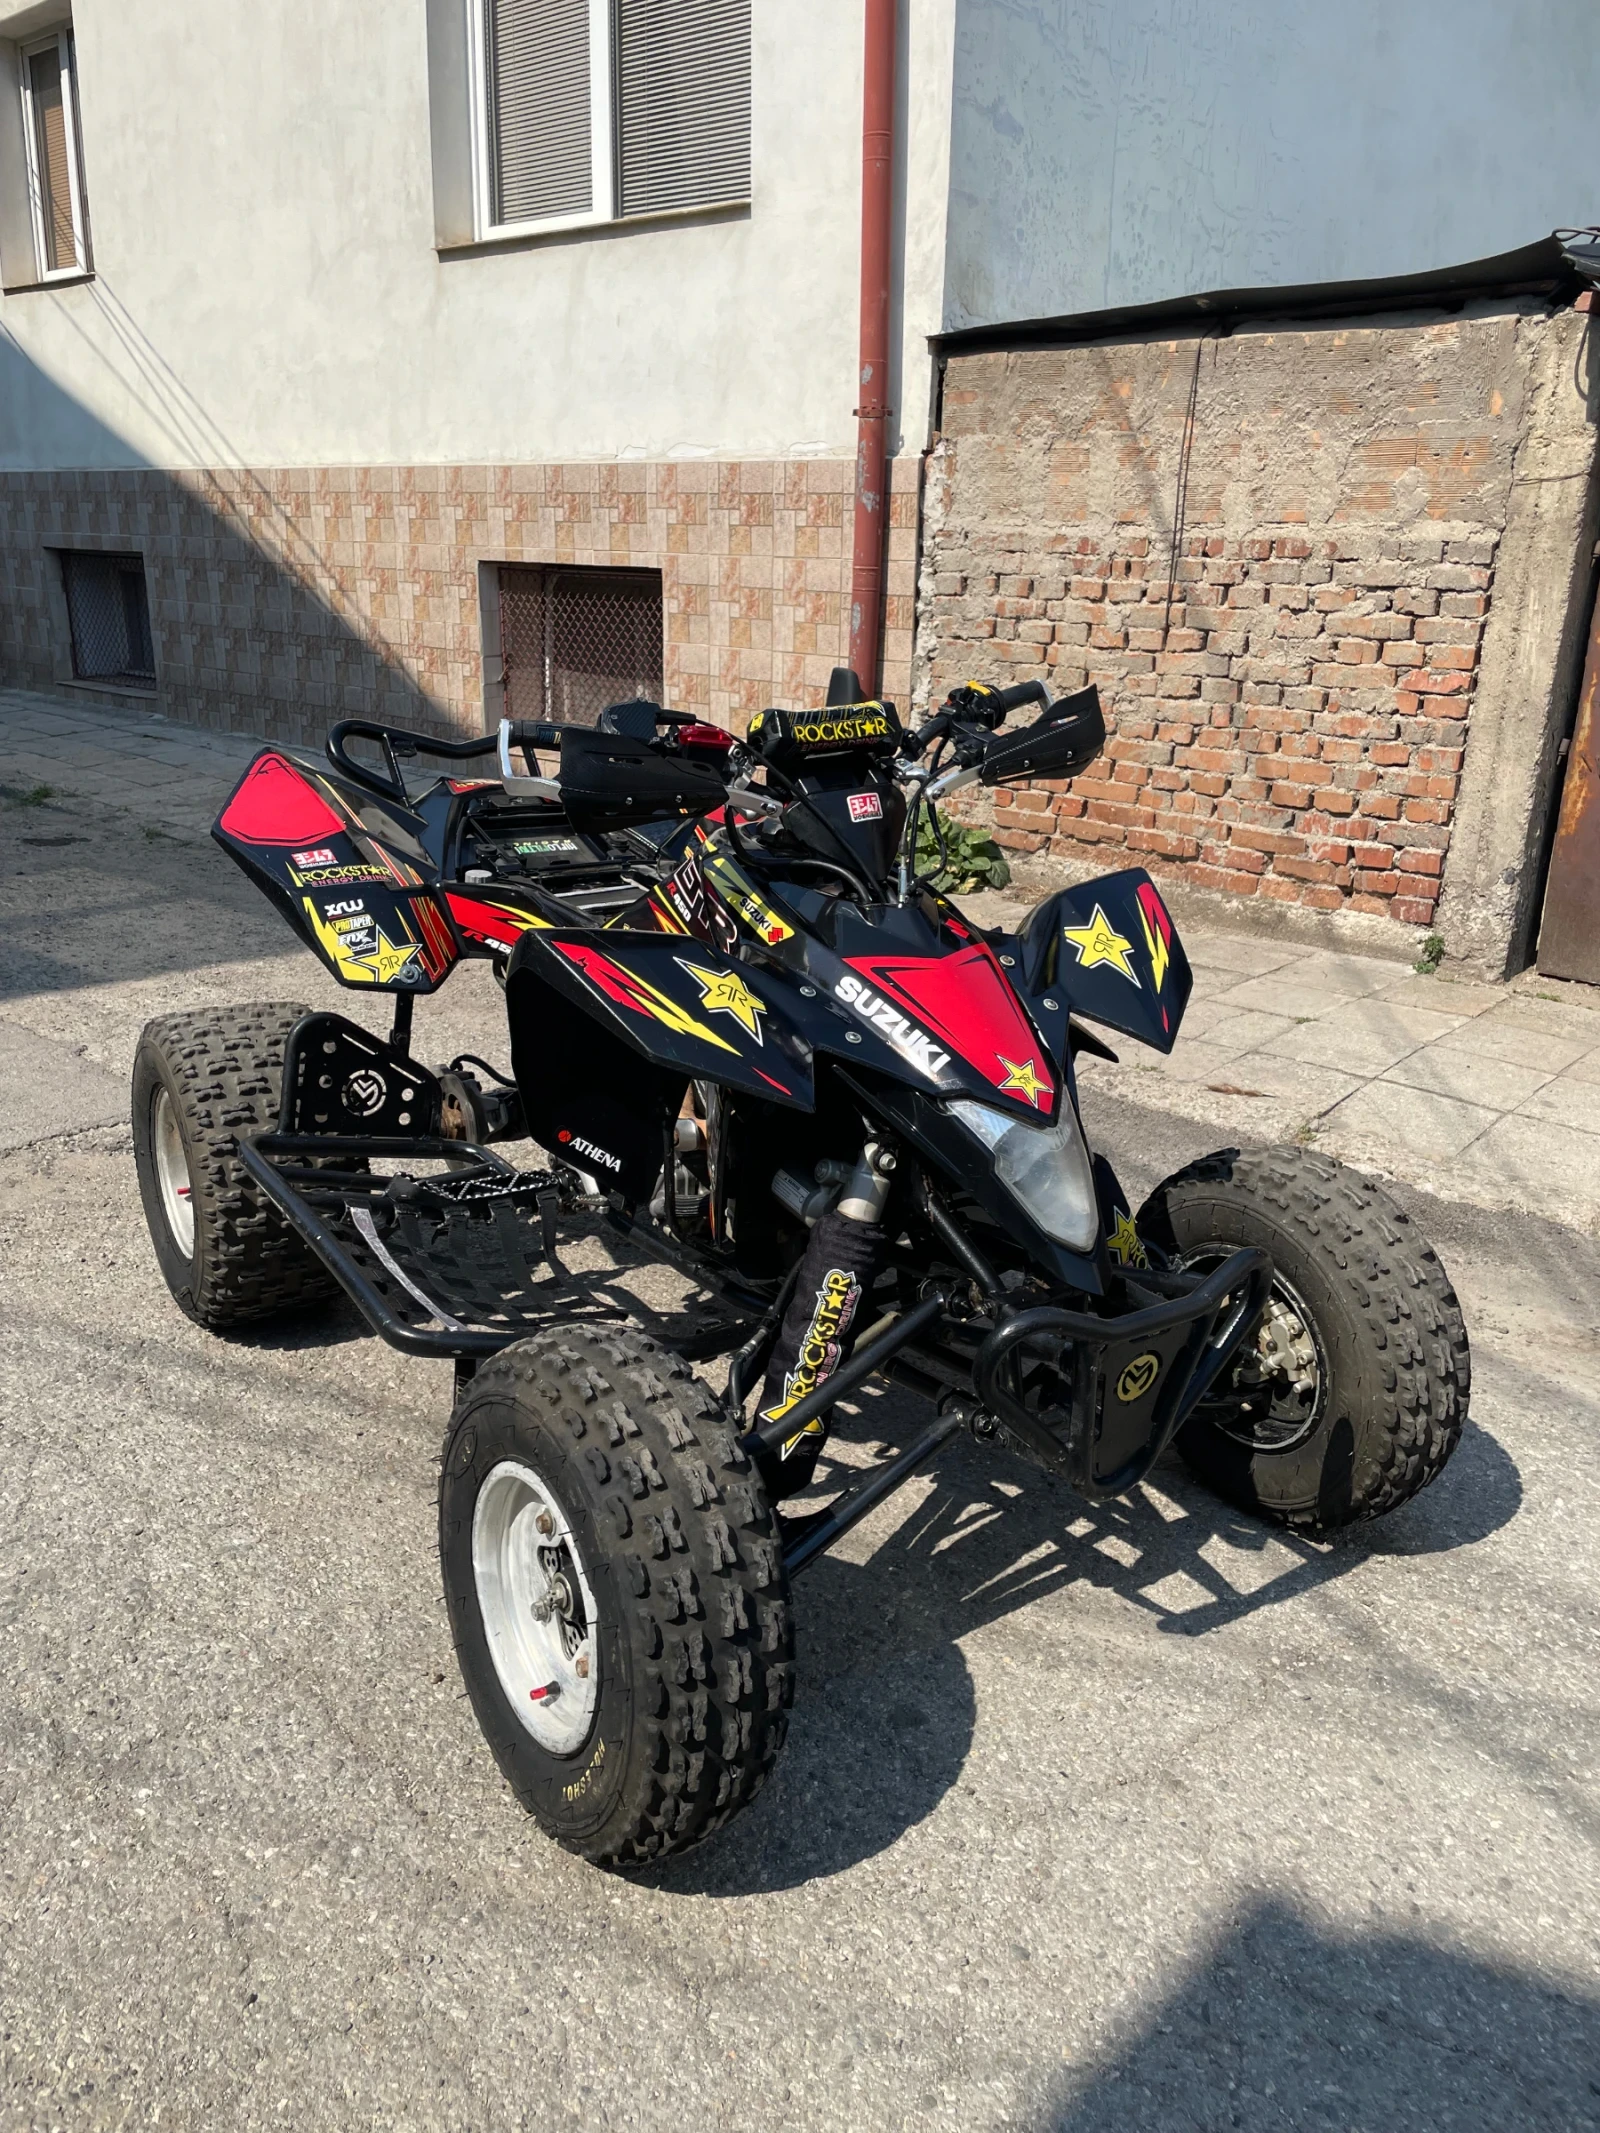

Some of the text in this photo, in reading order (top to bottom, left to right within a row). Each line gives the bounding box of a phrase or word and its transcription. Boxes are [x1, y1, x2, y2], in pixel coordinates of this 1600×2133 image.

[311, 876, 354, 887] ENERGY
[739, 897, 772, 931] SUZUKI
[462, 930, 513, 955] R45
[834, 976, 952, 1074] SUZUKI
[568, 1136, 622, 1173] ATHENA
